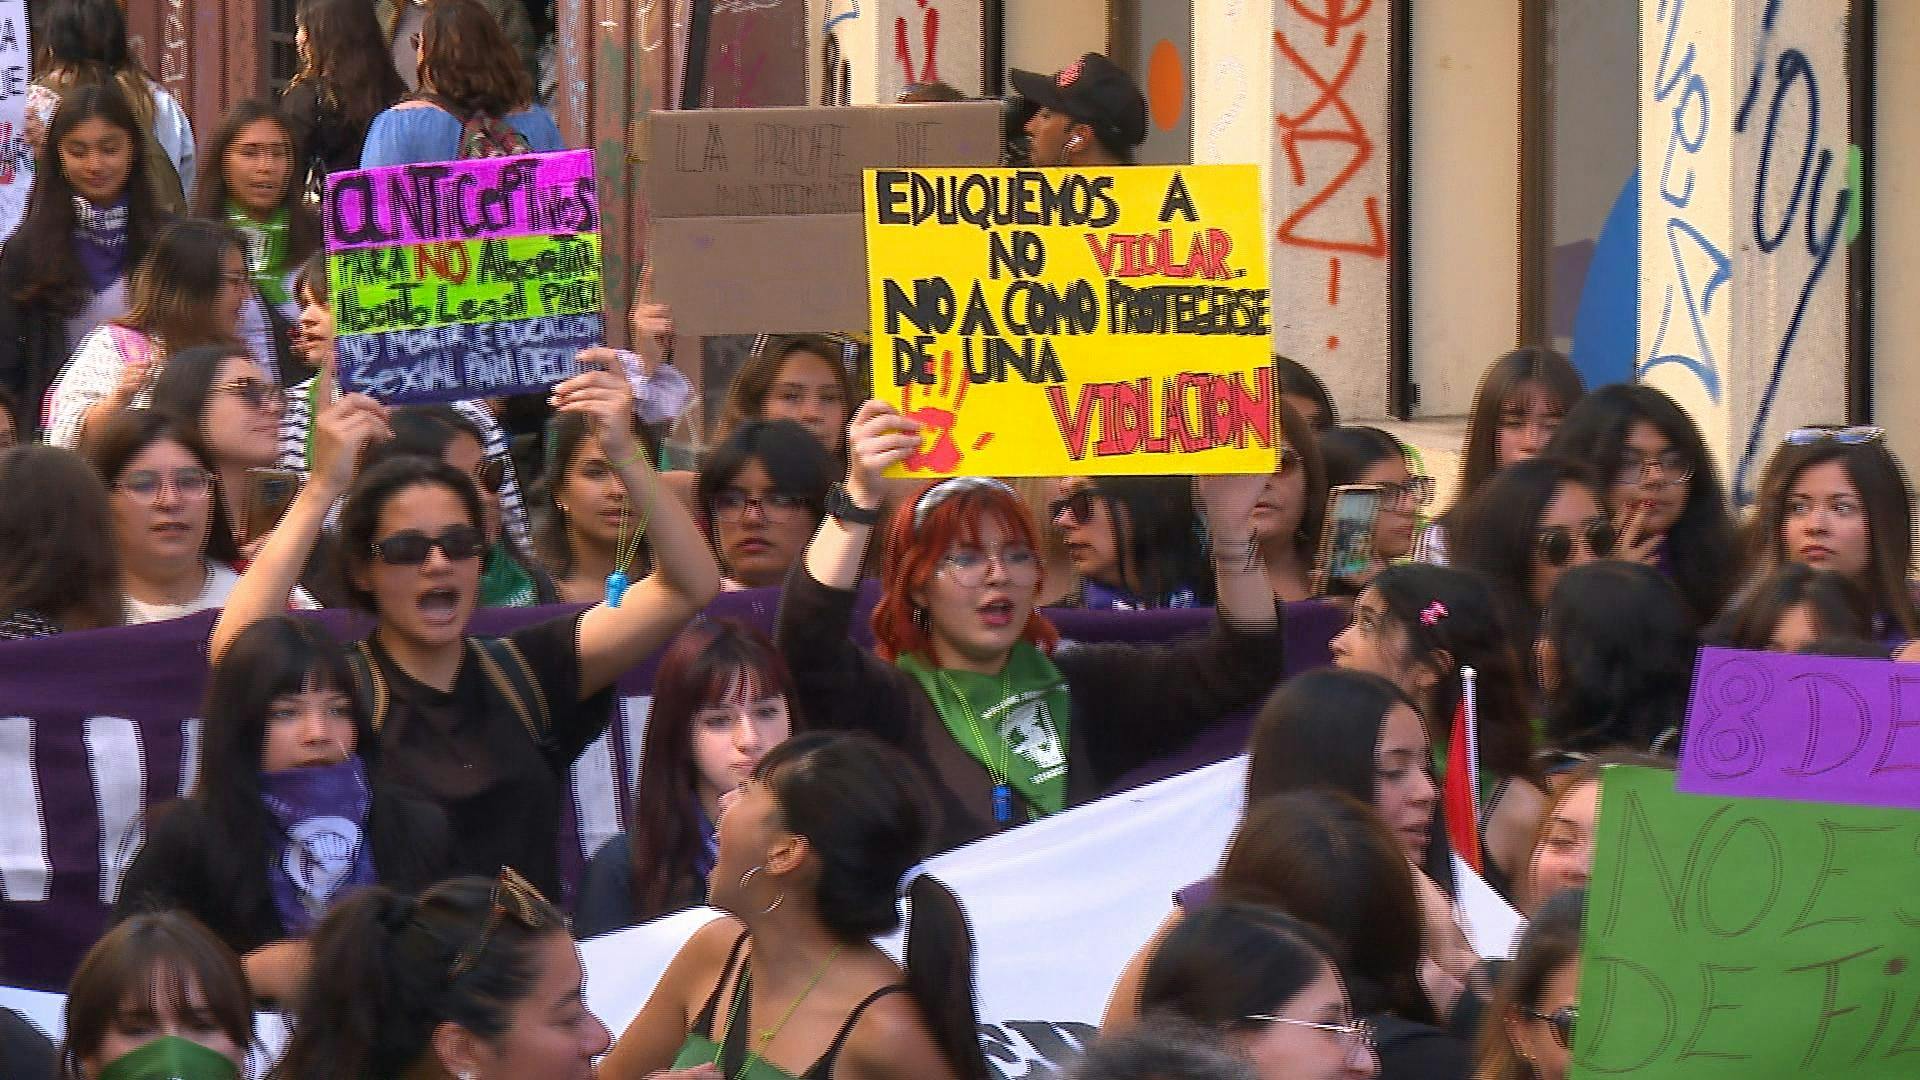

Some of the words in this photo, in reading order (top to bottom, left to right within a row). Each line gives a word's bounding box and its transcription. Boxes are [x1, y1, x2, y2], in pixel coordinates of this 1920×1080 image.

[675, 122, 727, 173] LA
[754, 121, 852, 178] PROFE
[713, 183, 863, 214] MATEMAT
[876, 170, 1119, 230] EDUQUEMOS
[1159, 172, 1197, 222] A
[338, 244, 408, 286] PARA
[414, 239, 470, 285] NO
[989, 231, 1044, 280] NO
[1086, 229, 1246, 280] VIOLAR.
[539, 279, 602, 317] PARA
[884, 277, 956, 335] NO
[958, 279, 998, 336] A
[1001, 277, 1097, 336] COMO
[1106, 280, 1270, 336] PROTEGERSE
[339, 332, 379, 367] NO
[894, 336, 935, 387] DE
[963, 338, 1065, 384] UNA
[1047, 368, 1274, 460] VIOLACION
[1694, 659, 1773, 781] 8
[1781, 674, 1920, 778] DE
[1602, 791, 1780, 938] NO
[1571, 956, 1757, 1074] DE
